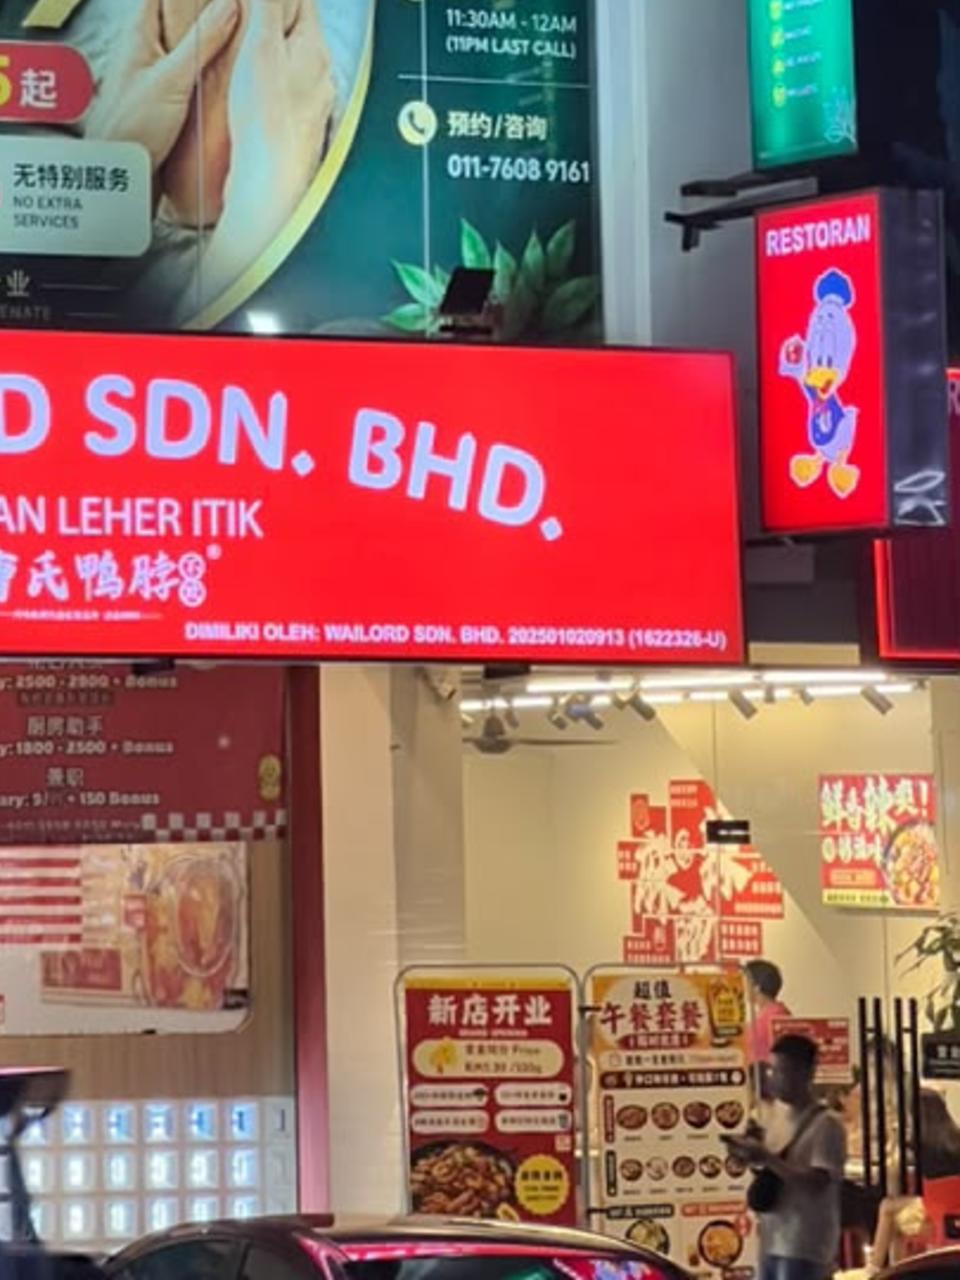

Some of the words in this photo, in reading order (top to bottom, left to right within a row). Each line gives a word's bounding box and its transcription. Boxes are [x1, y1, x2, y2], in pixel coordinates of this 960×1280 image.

[445, 8, 517, 30] 11:30AM
[531, 14, 577, 34] 12AM
[445, 34, 489, 54] (11PM
[492, 38, 530, 56] LAST
[532, 39, 578, 61] CALL)
[19, 68, 59, 109] 起
[12, 161, 132, 195] 无特别服务
[447, 154, 541, 182] 011-7608
[545, 159, 591, 183] 9161
[12, 195, 35, 210] NO
[37, 196, 84, 212] EXTRA
[12, 213, 80, 231] SERVICES
[765, 213, 872, 258] RESTORAN
[82, 373, 316, 478] SDN.
[347, 406, 565, 542] BHD.
[57, 495, 182, 538] LEHER
[191, 498, 265, 539] ITIK
[184, 621, 260, 640] DIMILIKI
[263, 623, 319, 641] OLEH:
[323, 623, 411, 643] WAILORD
[413, 625, 457, 644] SDN.
[459, 626, 504, 645] BHD.
[124, 676, 178, 690] Bonus
[121, 740, 175, 754] Bonus
[109, 793, 161, 807] Bonus
[632, 979, 672, 1001] 超值
[427, 993, 553, 1027] 新店开业
[600, 1000, 704, 1035] 午餐套餐
